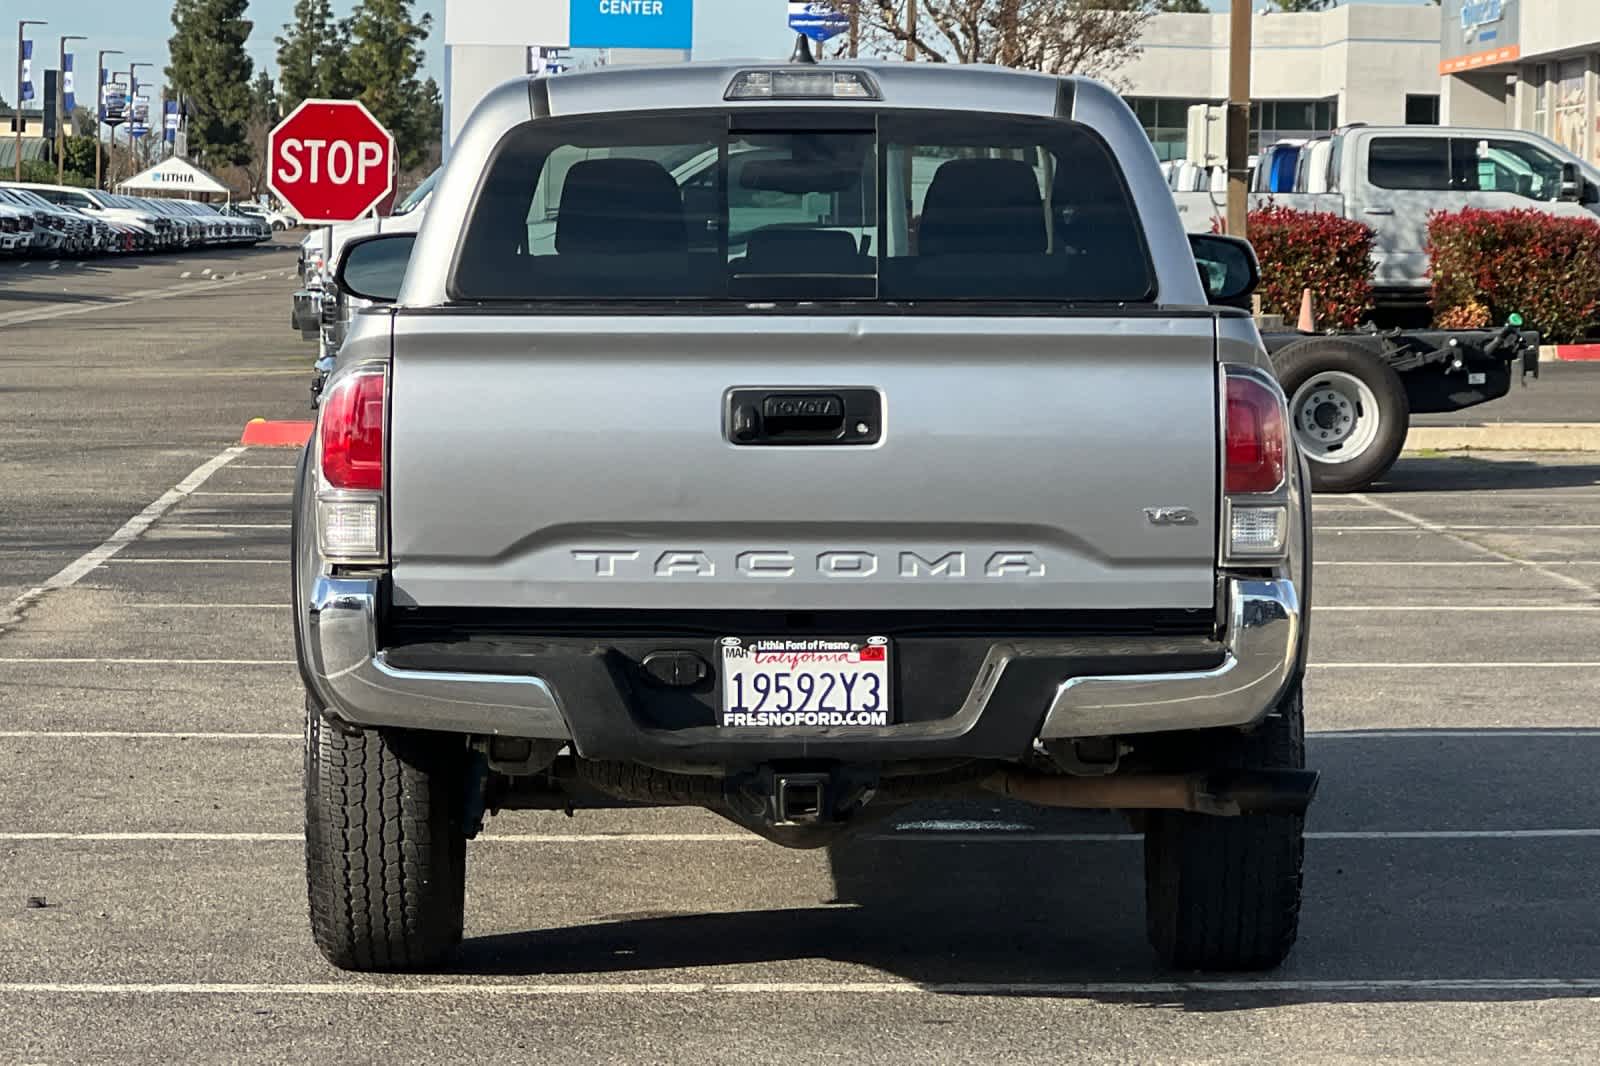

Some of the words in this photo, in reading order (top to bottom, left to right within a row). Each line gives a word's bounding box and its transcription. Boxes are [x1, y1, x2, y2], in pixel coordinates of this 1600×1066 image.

[600, 0, 663, 15] CENTER
[278, 138, 383, 185] STOP
[162, 172, 194, 183] LITHIA
[571, 550, 1045, 577] TACOMA
[757, 640, 785, 650] Lithia
[786, 640, 806, 650] Ford
[807, 640, 818, 650] of
[819, 640, 850, 650] Fresno
[754, 652, 860, 670] California
[731, 672, 881, 712] 19592Y3
[723, 711, 887, 726] FRESNOFORD.COM
